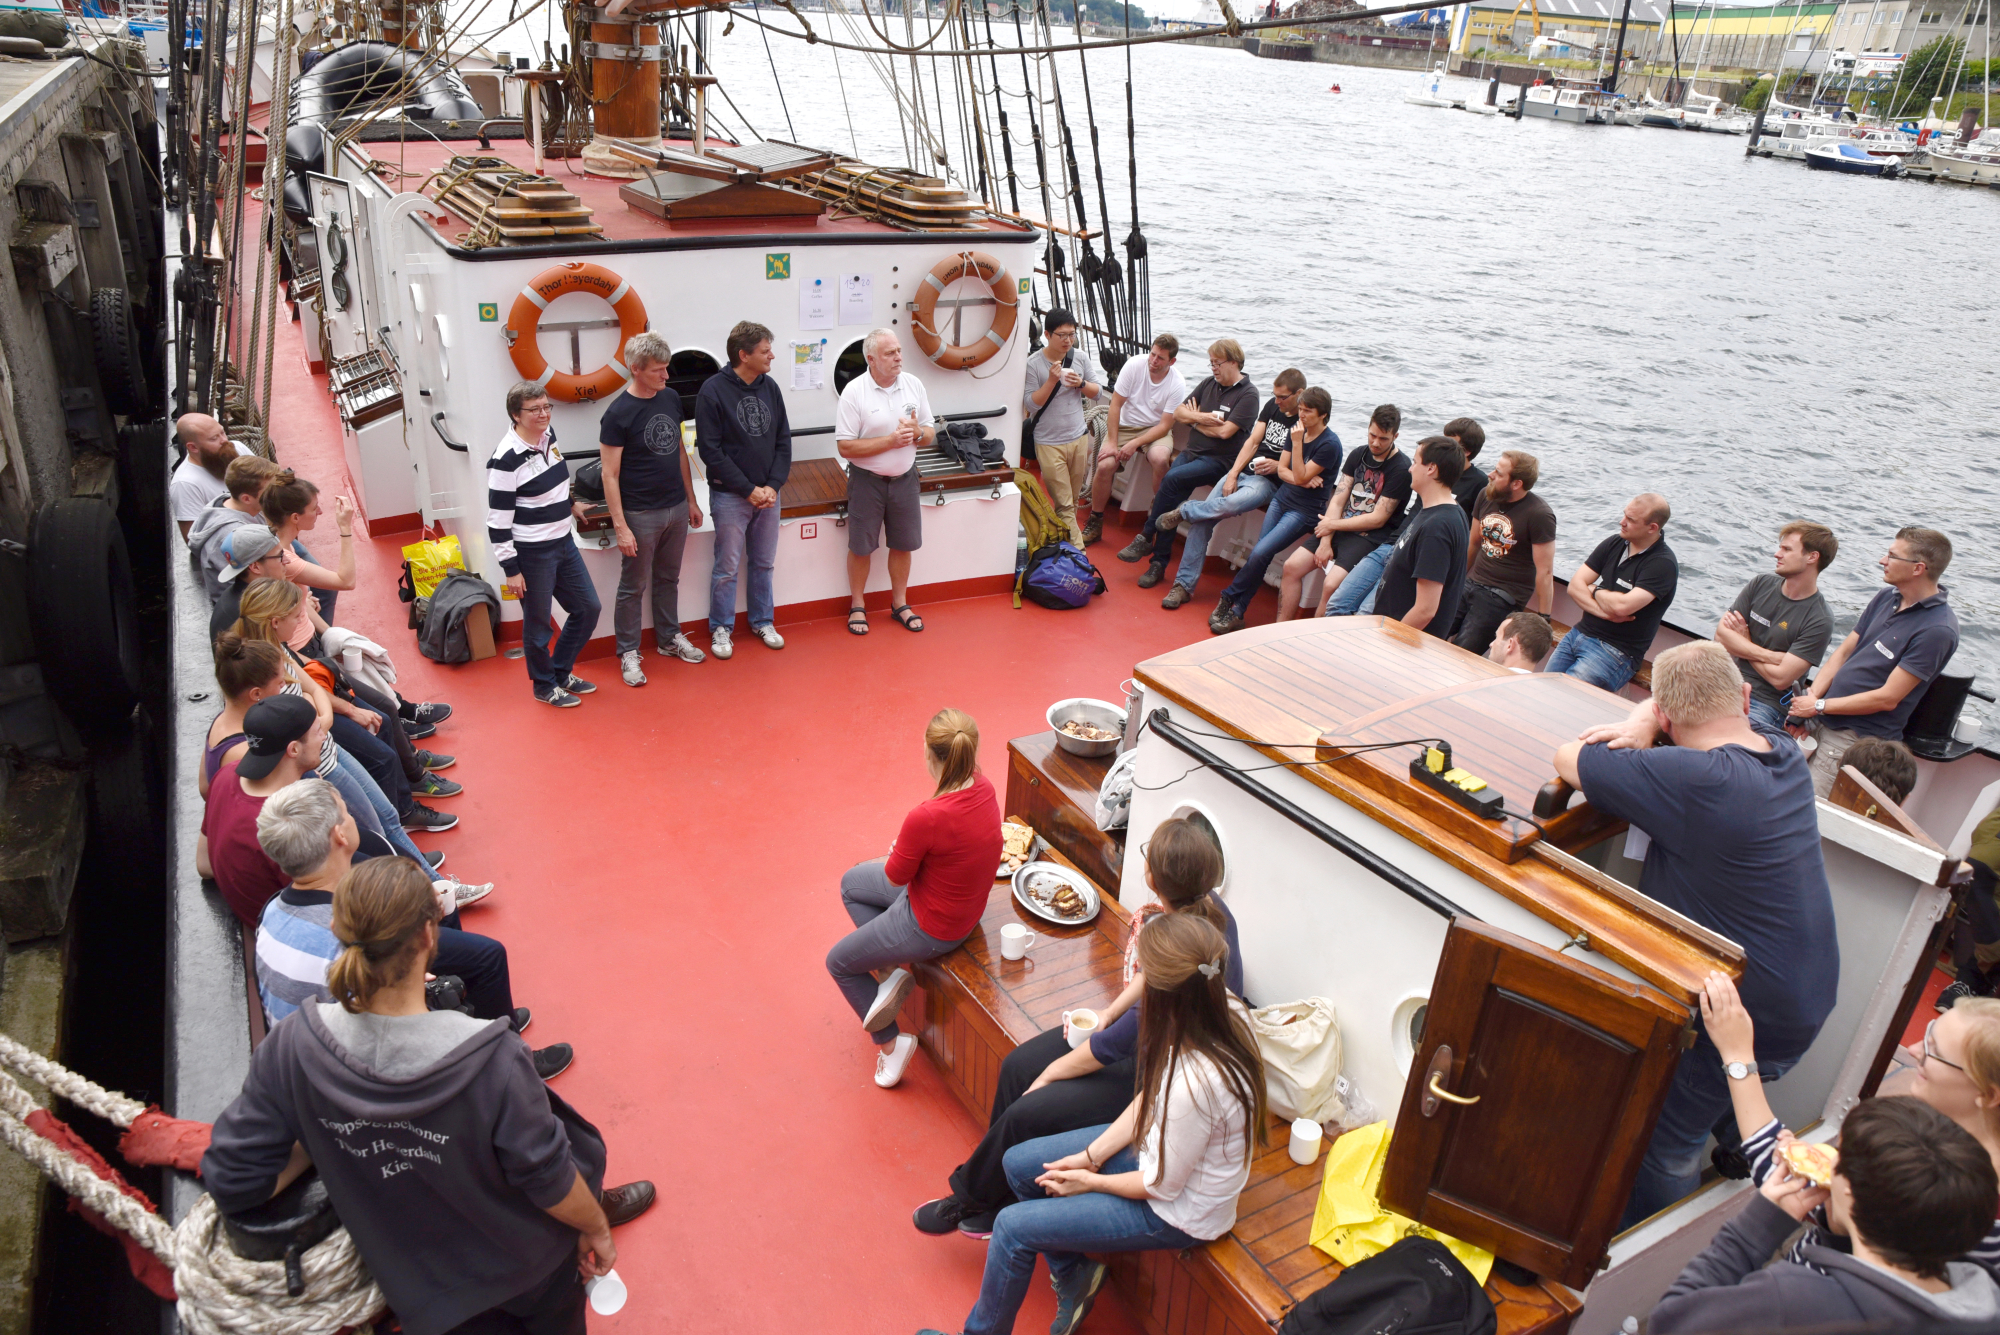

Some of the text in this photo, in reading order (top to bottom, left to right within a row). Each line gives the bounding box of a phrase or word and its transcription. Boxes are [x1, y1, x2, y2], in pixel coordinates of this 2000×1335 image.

[1954, 128, 1963, 139] 6
[538, 278, 562, 296] Thor
[574, 385, 598, 396] Kiel
[1071, 577, 1090, 590] OUT
